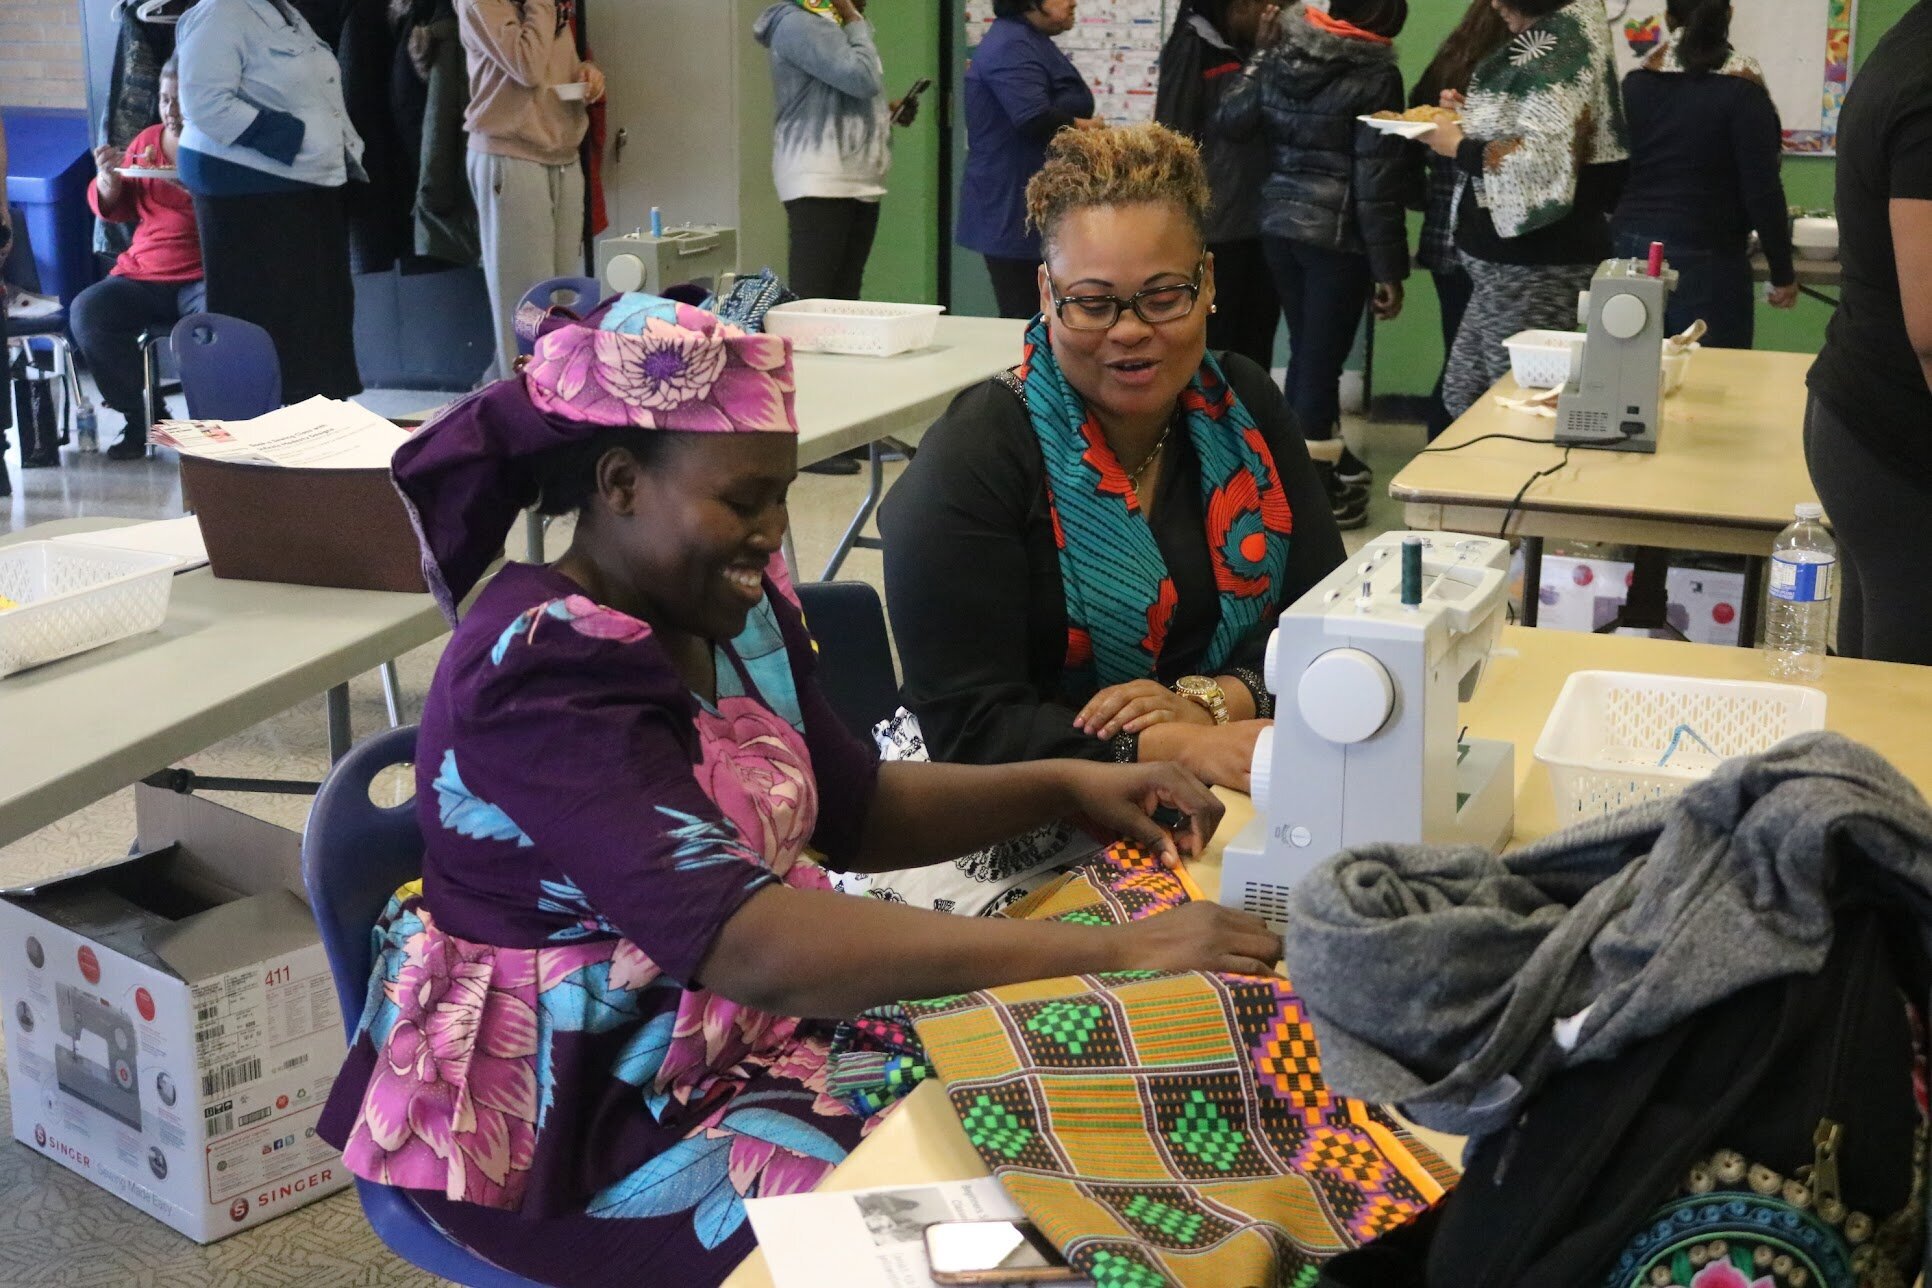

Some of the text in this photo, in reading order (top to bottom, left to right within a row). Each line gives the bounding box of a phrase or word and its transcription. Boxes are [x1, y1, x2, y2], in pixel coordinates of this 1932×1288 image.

[265, 965, 290, 987] 411
[49, 1136, 90, 1168] SINGER
[127, 1179, 151, 1202] Made
[152, 1192, 173, 1216] Easy
[258, 1169, 332, 1207] SINGER
